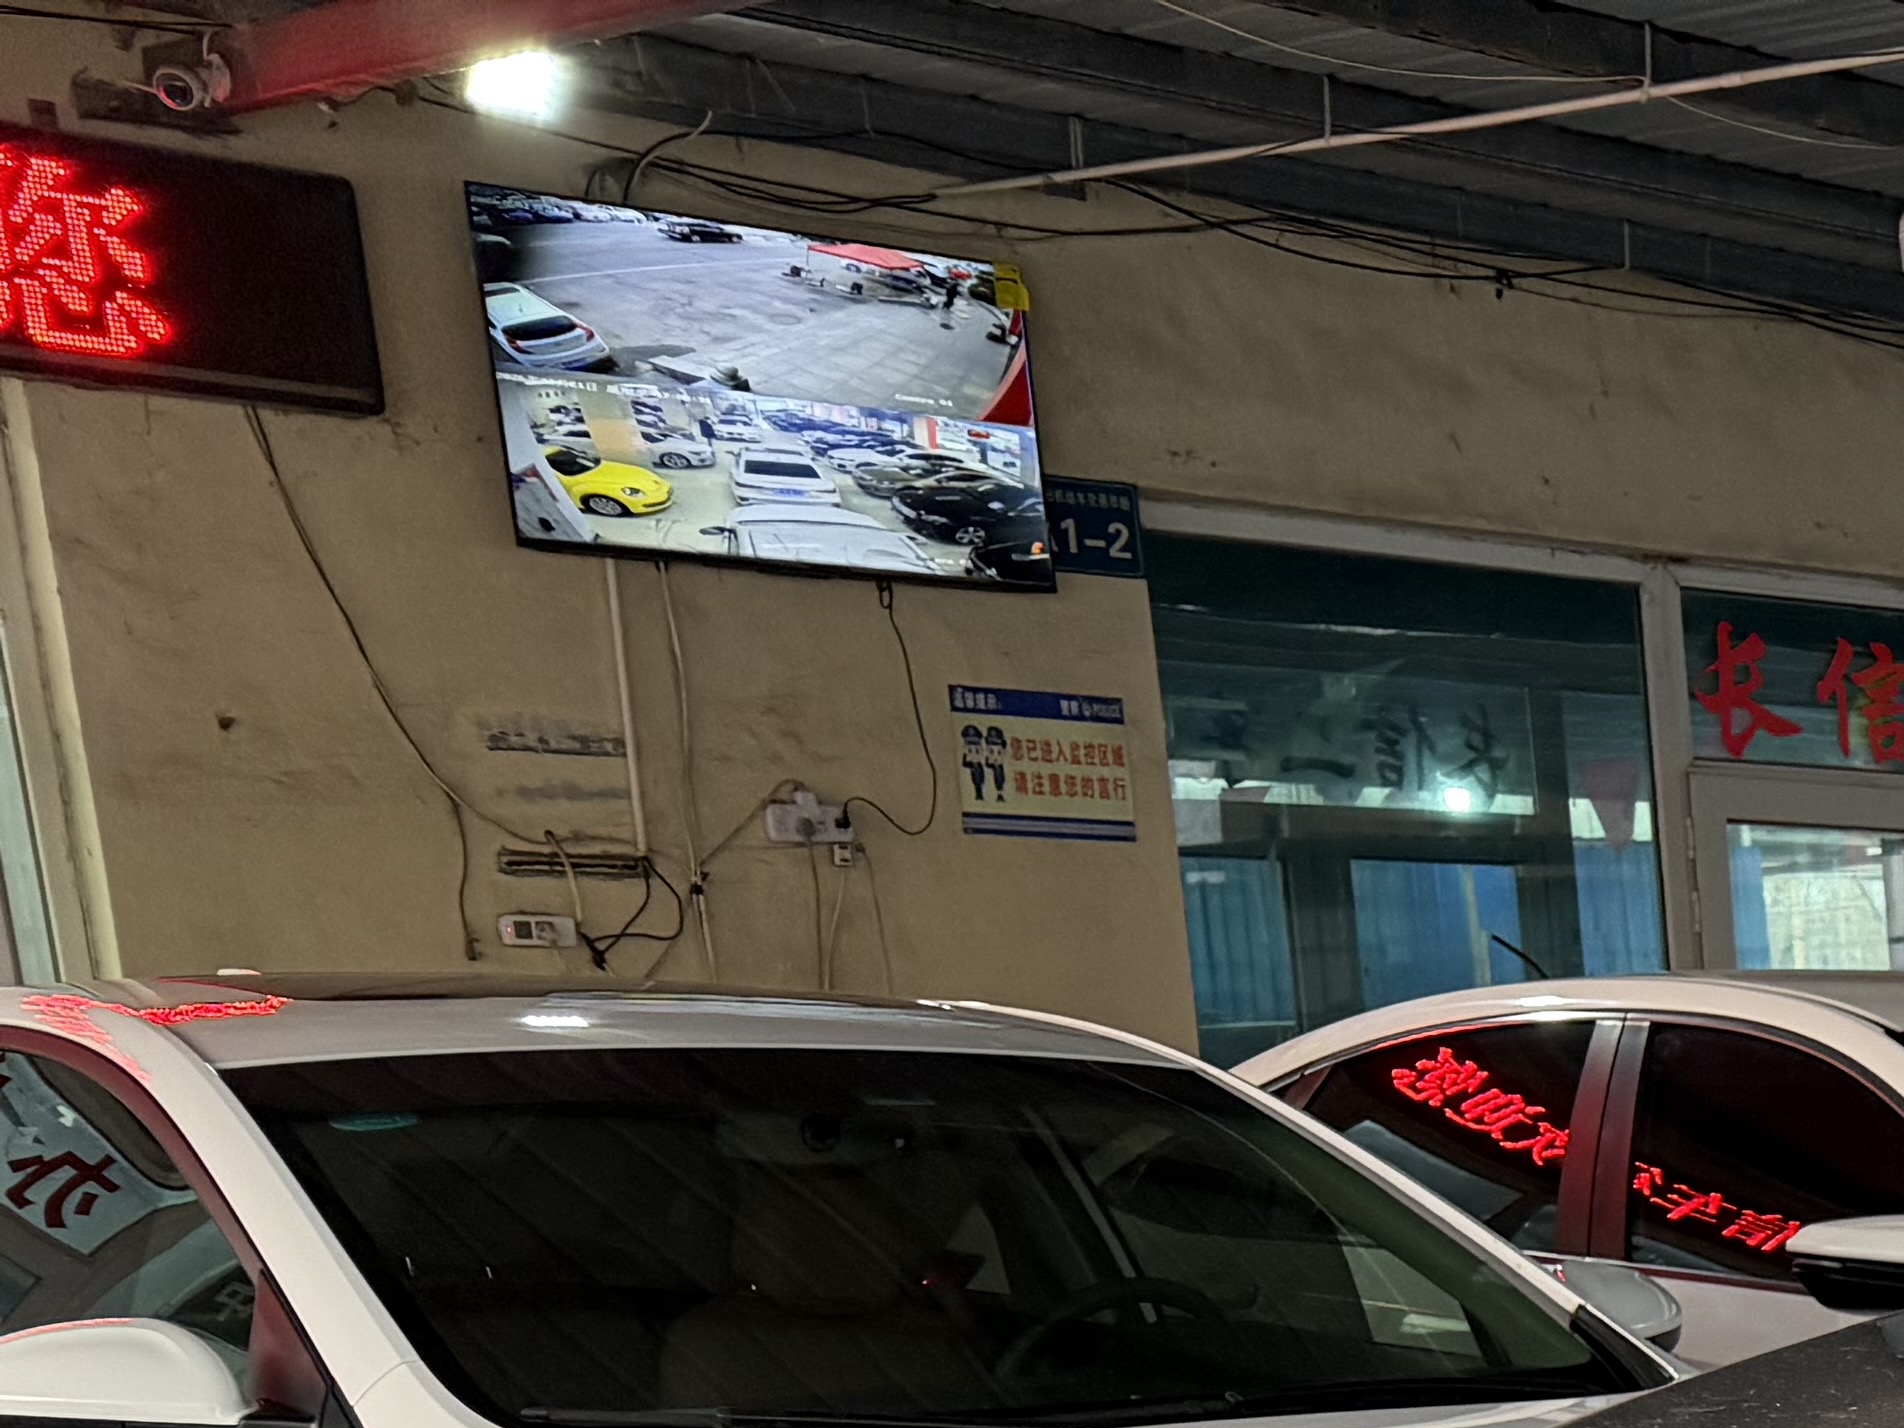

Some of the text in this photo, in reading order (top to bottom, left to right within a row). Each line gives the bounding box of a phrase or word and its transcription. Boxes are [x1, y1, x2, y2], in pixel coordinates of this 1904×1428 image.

[0, 146, 173, 354] 您
[1049, 518, 1132, 559] 1-2
[1010, 736, 1126, 768] 您已进入监控区域
[1014, 770, 1127, 802] 请注意您的言行
